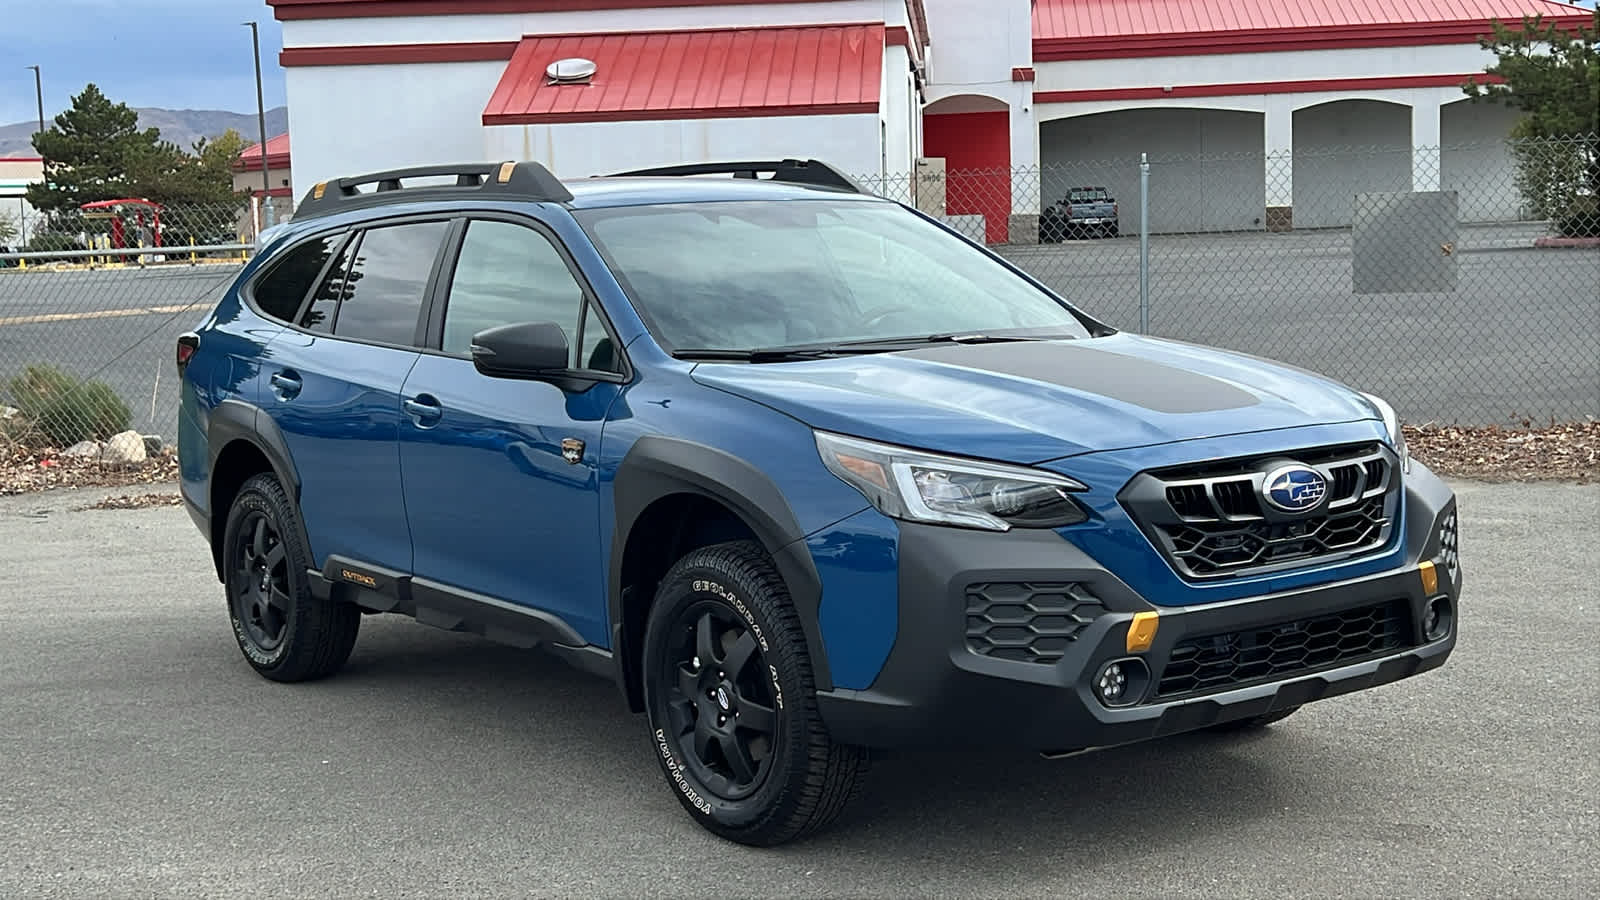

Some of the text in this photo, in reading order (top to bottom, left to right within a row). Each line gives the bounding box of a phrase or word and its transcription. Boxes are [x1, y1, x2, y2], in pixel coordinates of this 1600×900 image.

[692, 580, 784, 710] GEOLANDAR A/T
[655, 728, 712, 815] YOKOHAMA
